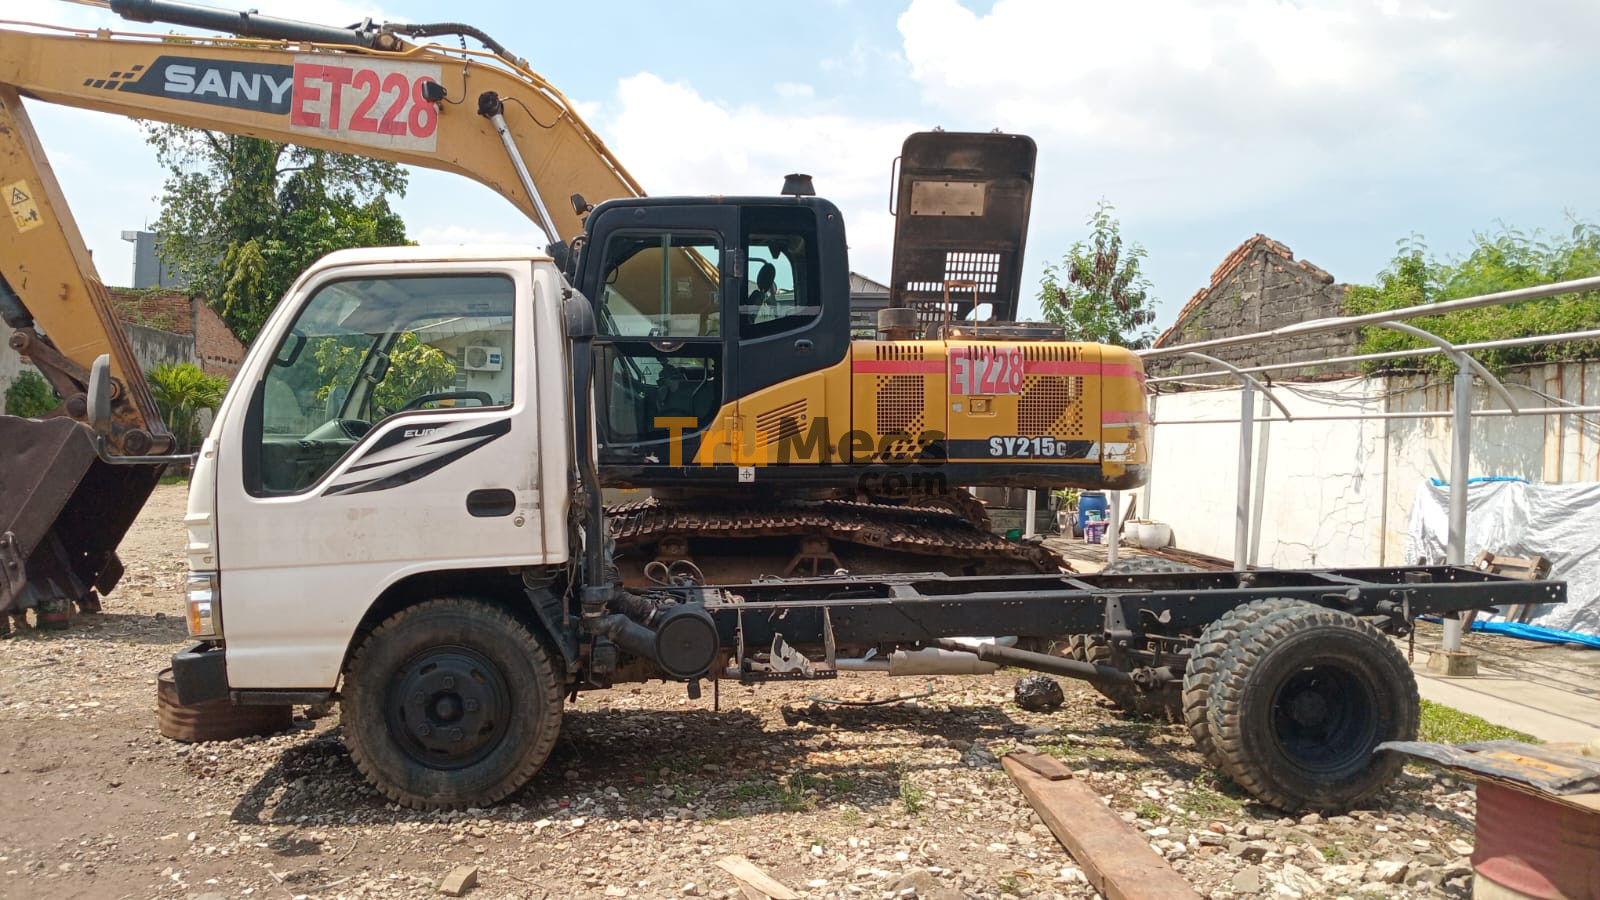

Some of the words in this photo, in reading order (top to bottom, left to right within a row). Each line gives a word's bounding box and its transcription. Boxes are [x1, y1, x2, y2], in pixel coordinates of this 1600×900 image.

[164, 64, 293, 104] SANY
[291, 63, 438, 138] ET228
[951, 347, 1024, 394] ET228
